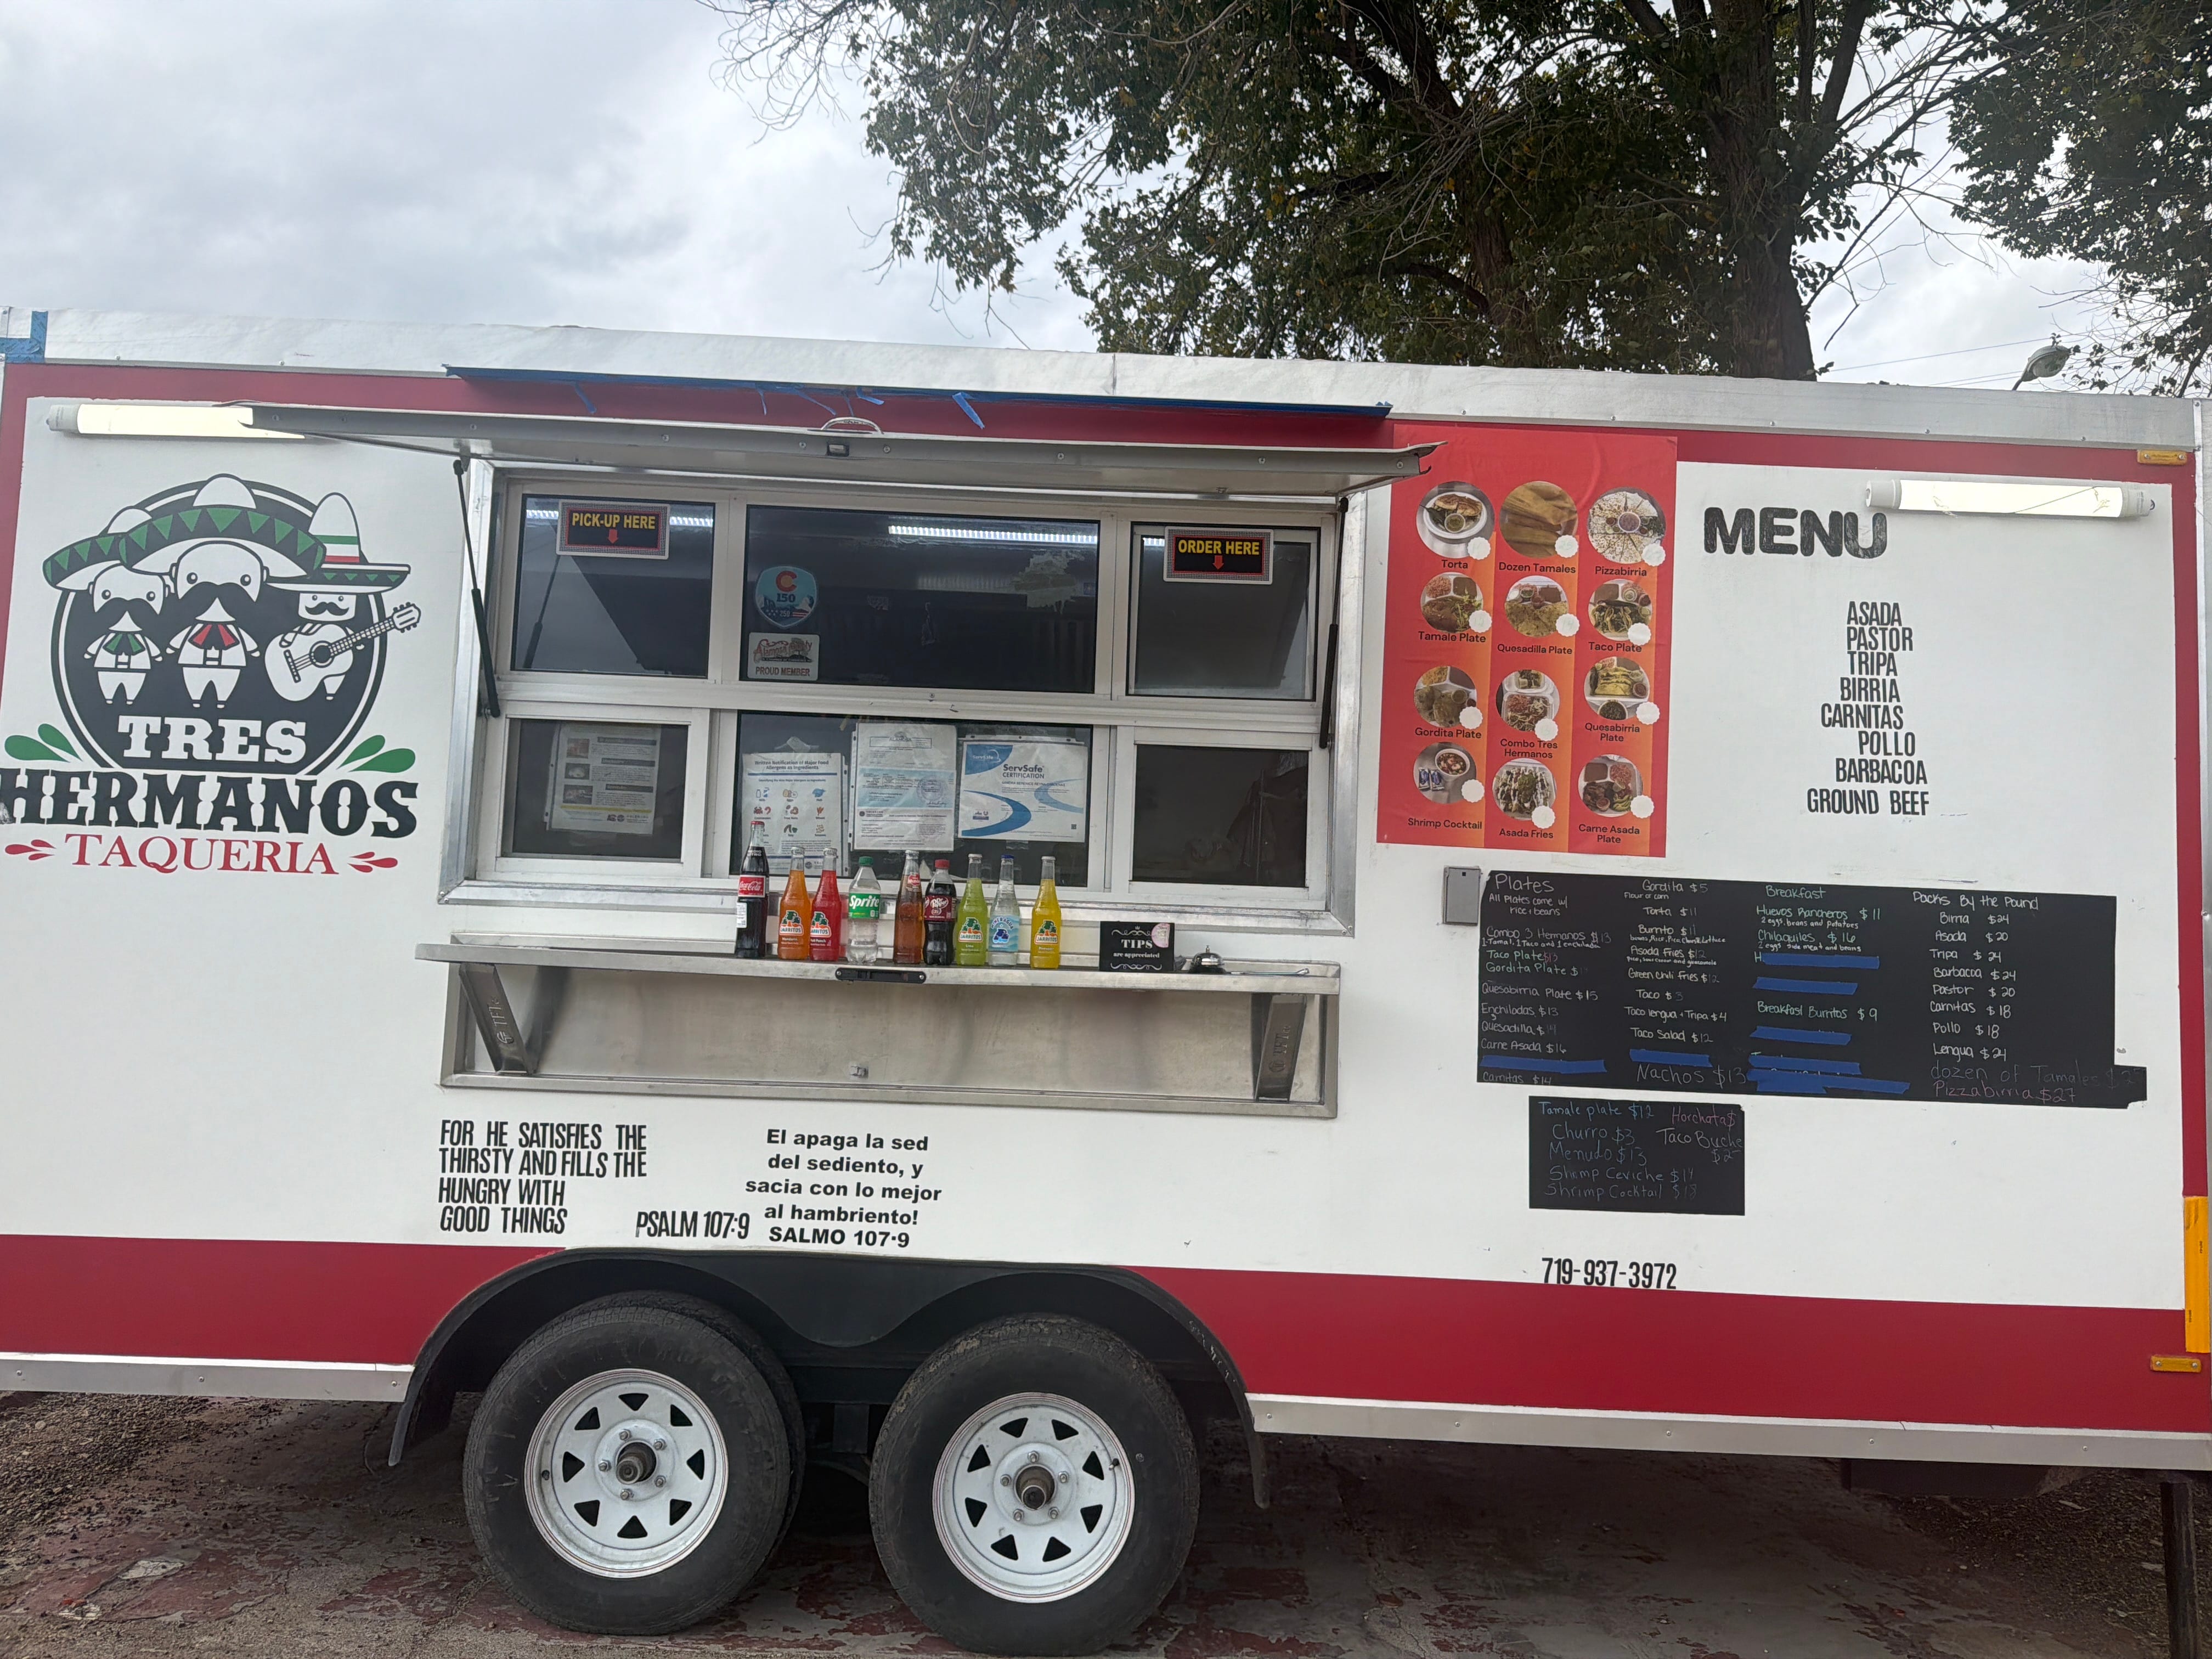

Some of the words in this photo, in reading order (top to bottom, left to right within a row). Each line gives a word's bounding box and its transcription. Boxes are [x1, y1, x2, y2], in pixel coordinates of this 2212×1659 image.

[572, 512, 620, 528] PICK-UP
[623, 515, 655, 529] HERE
[1704, 506, 1887, 559] MENU
[1178, 539, 1222, 555] ORDER
[1226, 541, 1260, 555] HERE
[1442, 560, 1469, 569] Torta
[1499, 562, 1531, 572] Dozen
[1533, 563, 1576, 574] Tamales
[1595, 566, 1647, 577] Pizzabirria
[777, 594, 795, 602] 150
[1847, 601, 1902, 627] ASADA
[1418, 631, 1455, 643] Tamale
[1459, 633, 1486, 644] Plate
[1847, 627, 1914, 651] PASTOR
[1497, 645, 1546, 656] Quesadilla
[1548, 645, 1572, 655] Plate
[1589, 642, 1613, 652] Taco
[1616, 644, 1642, 653] Plate
[1847, 651, 1898, 676] TRIPA
[755, 667, 779, 675] PROUD
[781, 667, 810, 676] MEMBER
[1840, 677, 1901, 703] BIRRIA
[1821, 703, 1904, 730] CARNITAS
[1415, 727, 1453, 738] Gordita
[1455, 730, 1482, 739] Plate
[1585, 723, 1640, 735] Quesabirria
[117, 714, 307, 764] TRES
[1500, 739, 1535, 749] Combo
[1537, 740, 1558, 749] Tres
[1600, 732, 1624, 742] Plate
[1858, 731, 1916, 757] POLLO
[1504, 749, 1553, 759] Hermanos
[1003, 764, 1042, 772] ServSafe
[1836, 758, 1928, 785] BARBACOA
[0, 768, 419, 839] HERMANOS
[1807, 788, 1879, 815] GROUND
[1891, 790, 1929, 816] BEEF
[1408, 818, 1441, 830] Shrimp
[1443, 819, 1482, 830] Cocktail
[1579, 824, 1607, 834] Carne
[1610, 825, 1640, 835] Asada
[1499, 828, 1528, 838] Asada
[1531, 830, 1554, 839] Fries
[1597, 835, 1621, 844] Plate
[64, 833, 340, 875] TAQUERIA
[1496, 873, 1554, 893] Plates
[1643, 879, 1684, 892] Gordita
[1766, 885, 1826, 899] Breakfast
[849, 895, 879, 910] Sprite
[1489, 893, 1500, 902] All
[1504, 895, 1530, 904] Plates
[1558, 896, 1567, 908] w/
[1960, 895, 1974, 911] By
[1980, 895, 1999, 907] the
[2005, 896, 2038, 910] Pound
[1643, 906, 1672, 916] Torta
[1756, 904, 1792, 917] Huevos
[1798, 907, 1848, 920] Rancheros
[1940, 912, 1969, 924] Birria
[1988, 914, 2009, 924] $24
[1758, 929, 1815, 943] Chilaquiles
[1936, 930, 1966, 942] Asada
[1121, 939, 1153, 949] TIPS
[1630, 945, 1659, 953] Asada
[1663, 948, 1684, 958] Fries
[1486, 950, 1509, 958] Taco
[1514, 950, 1544, 961] Plate
[1929, 949, 1957, 960] Tripa
[1628, 967, 1654, 979] Green
[1677, 971, 1699, 982] Fries
[1933, 966, 1982, 979] Barbacoa
[1990, 969, 2016, 981] $24
[1482, 983, 1539, 996] Quesabirria
[1545, 988, 1572, 1000] Plate
[1933, 984, 1974, 995] Pastor
[1539, 1005, 1559, 1017] $13
[1758, 1001, 1803, 1016] Breakfast
[1808, 1006, 1848, 1019] Burritos
[1930, 1001, 1976, 1013] Carnitas
[1481, 1020, 1536, 1035] Quesadilla
[1630, 1028, 1654, 1038] Taco
[1657, 1029, 1685, 1042] Salad
[1933, 1022, 1960, 1033] Pollo
[1481, 1038, 1508, 1050] Carne
[1511, 1041, 1541, 1053] Asada
[1933, 1043, 1974, 1062] Lengua
[1980, 1048, 2006, 1062] $24
[1637, 1063, 1704, 1085] Nachos
[1713, 1065, 1746, 1089] $13
[1538, 1102, 1581, 1116] Tamale
[1587, 1102, 1622, 1121] plate
[1628, 1103, 1655, 1120] $12
[440, 1119, 475, 1146] FOR
[487, 1121, 508, 1147] HE
[518, 1122, 602, 1149] SATISFIES
[616, 1124, 647, 1150] THE
[767, 1128, 786, 1144] El
[793, 1133, 858, 1150] apaga
[866, 1133, 884, 1148] la
[891, 1136, 928, 1151] sed
[1553, 1121, 1607, 1140] Churro
[1612, 1126, 1635, 1146] $3
[1656, 1127, 1691, 1146] Taco
[1695, 1130, 1742, 1148] Buche
[1549, 1140, 1612, 1162] Menudo
[439, 1148, 514, 1174] THIRSTY
[518, 1150, 556, 1176] AND
[561, 1150, 608, 1178] FILLS
[613, 1152, 647, 1178] THE
[768, 1154, 800, 1170] del
[806, 1156, 904, 1177] sediento,
[911, 1163, 923, 1179] y
[438, 1177, 511, 1204] HUNGRY
[518, 1178, 566, 1206] WITH
[745, 1179, 803, 1195] sacia
[810, 1183, 848, 1197] con
[856, 1183, 874, 1198] lo
[881, 1186, 942, 1204] mejor
[1545, 1183, 1604, 1202] Shrimp
[1609, 1184, 1662, 1198] Cocktail
[440, 1205, 490, 1233] GOOD
[501, 1207, 568, 1234] THINGS
[764, 1204, 783, 1219] al
[791, 1205, 918, 1225] hambriento!
[635, 1210, 698, 1238] PSALM
[769, 1227, 845, 1245] SALMO
[1542, 1257, 1677, 1290] 719-937-3972
